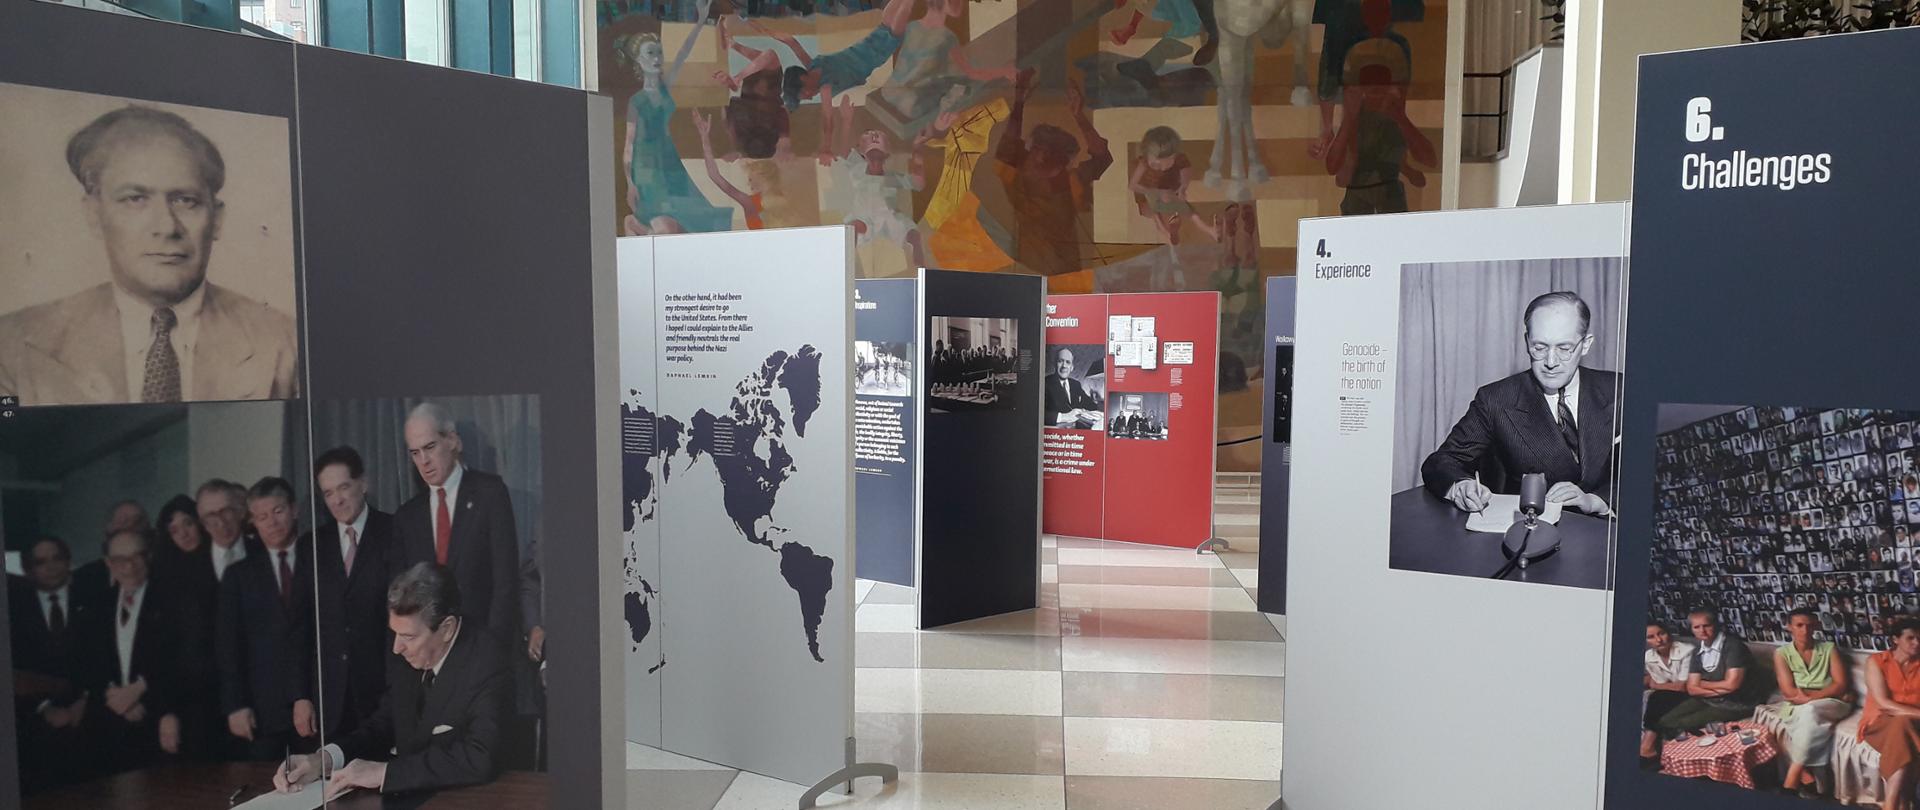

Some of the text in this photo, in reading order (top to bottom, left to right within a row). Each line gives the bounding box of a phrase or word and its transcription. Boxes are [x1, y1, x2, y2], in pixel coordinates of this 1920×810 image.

[1685, 97, 1725, 142] 6.
[1682, 150, 1832, 191] Challenges
[1316, 239, 1331, 258] 4.
[1315, 263, 1371, 280] Experience
[673, 293, 681, 301] the
[682, 293, 696, 301] other
[697, 293, 712, 302] hand,
[713, 293, 717, 301] it
[718, 292, 728, 301] had
[729, 292, 742, 301] been
[665, 305, 673, 313] my
[674, 304, 699, 313] strongest
[722, 304, 729, 313] go
[733, 313, 748, 321] there
[1046, 316, 1079, 328] Convention
[668, 324, 684, 333] hoped
[702, 324, 720, 333] explain
[676, 334, 696, 343] friendly
[666, 345, 686, 353] purpose
[687, 344, 705, 352] behind
[705, 344, 714, 352] the
[1343, 342, 1380, 356] Genocide
[676, 355, 694, 363] policy.
[1342, 360, 1385, 372] the birth of
[1341, 377, 1381, 390] the notion
